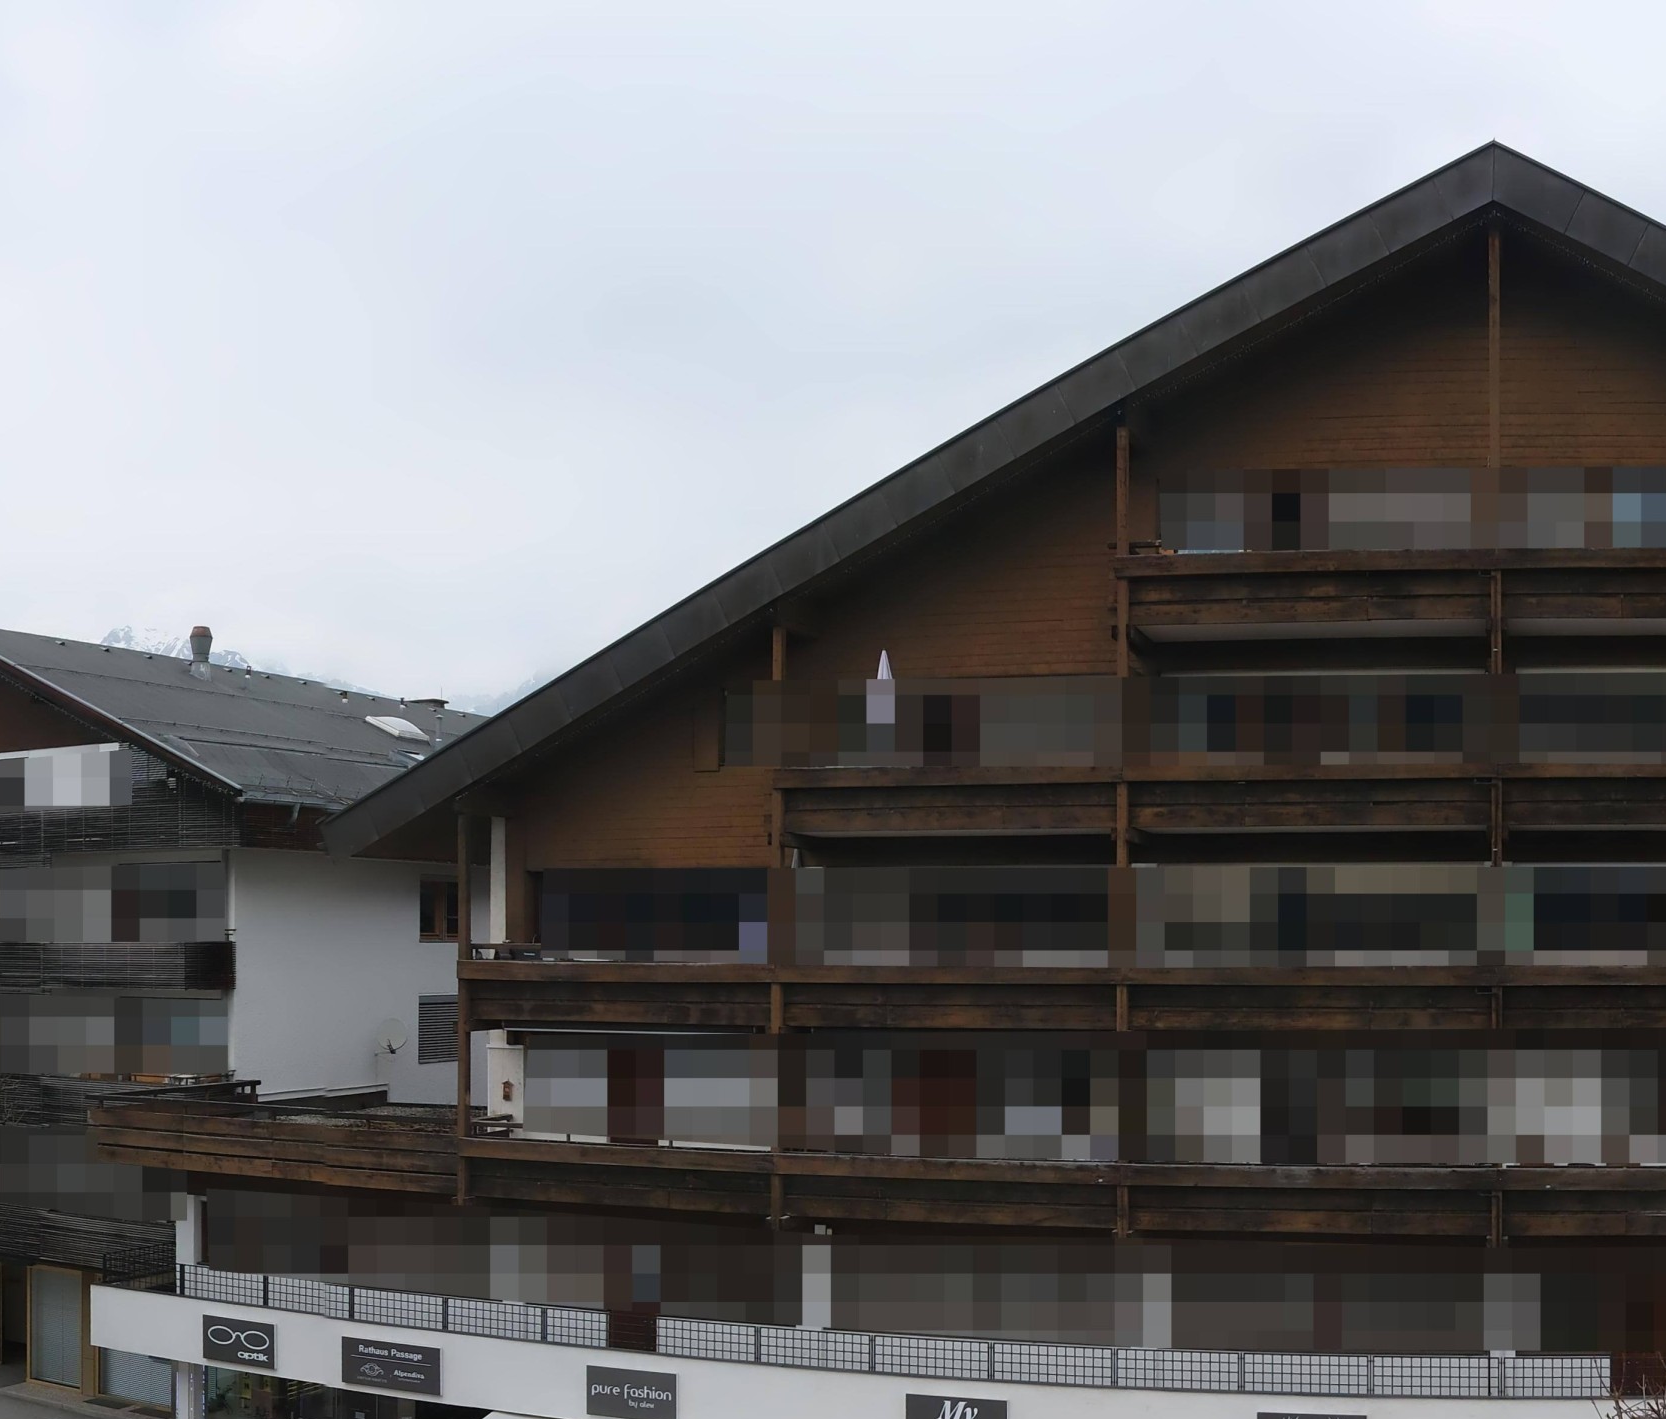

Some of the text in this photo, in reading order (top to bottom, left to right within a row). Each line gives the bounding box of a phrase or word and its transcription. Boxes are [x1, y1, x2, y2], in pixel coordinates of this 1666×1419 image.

[237, 1351, 269, 1362] optik
[358, 1344, 423, 1361] Rathaus Passage
[393, 1369, 425, 1380] Alpendiva
[591, 1383, 672, 1401] pure fashion
[628, 1400, 638, 1408] by
